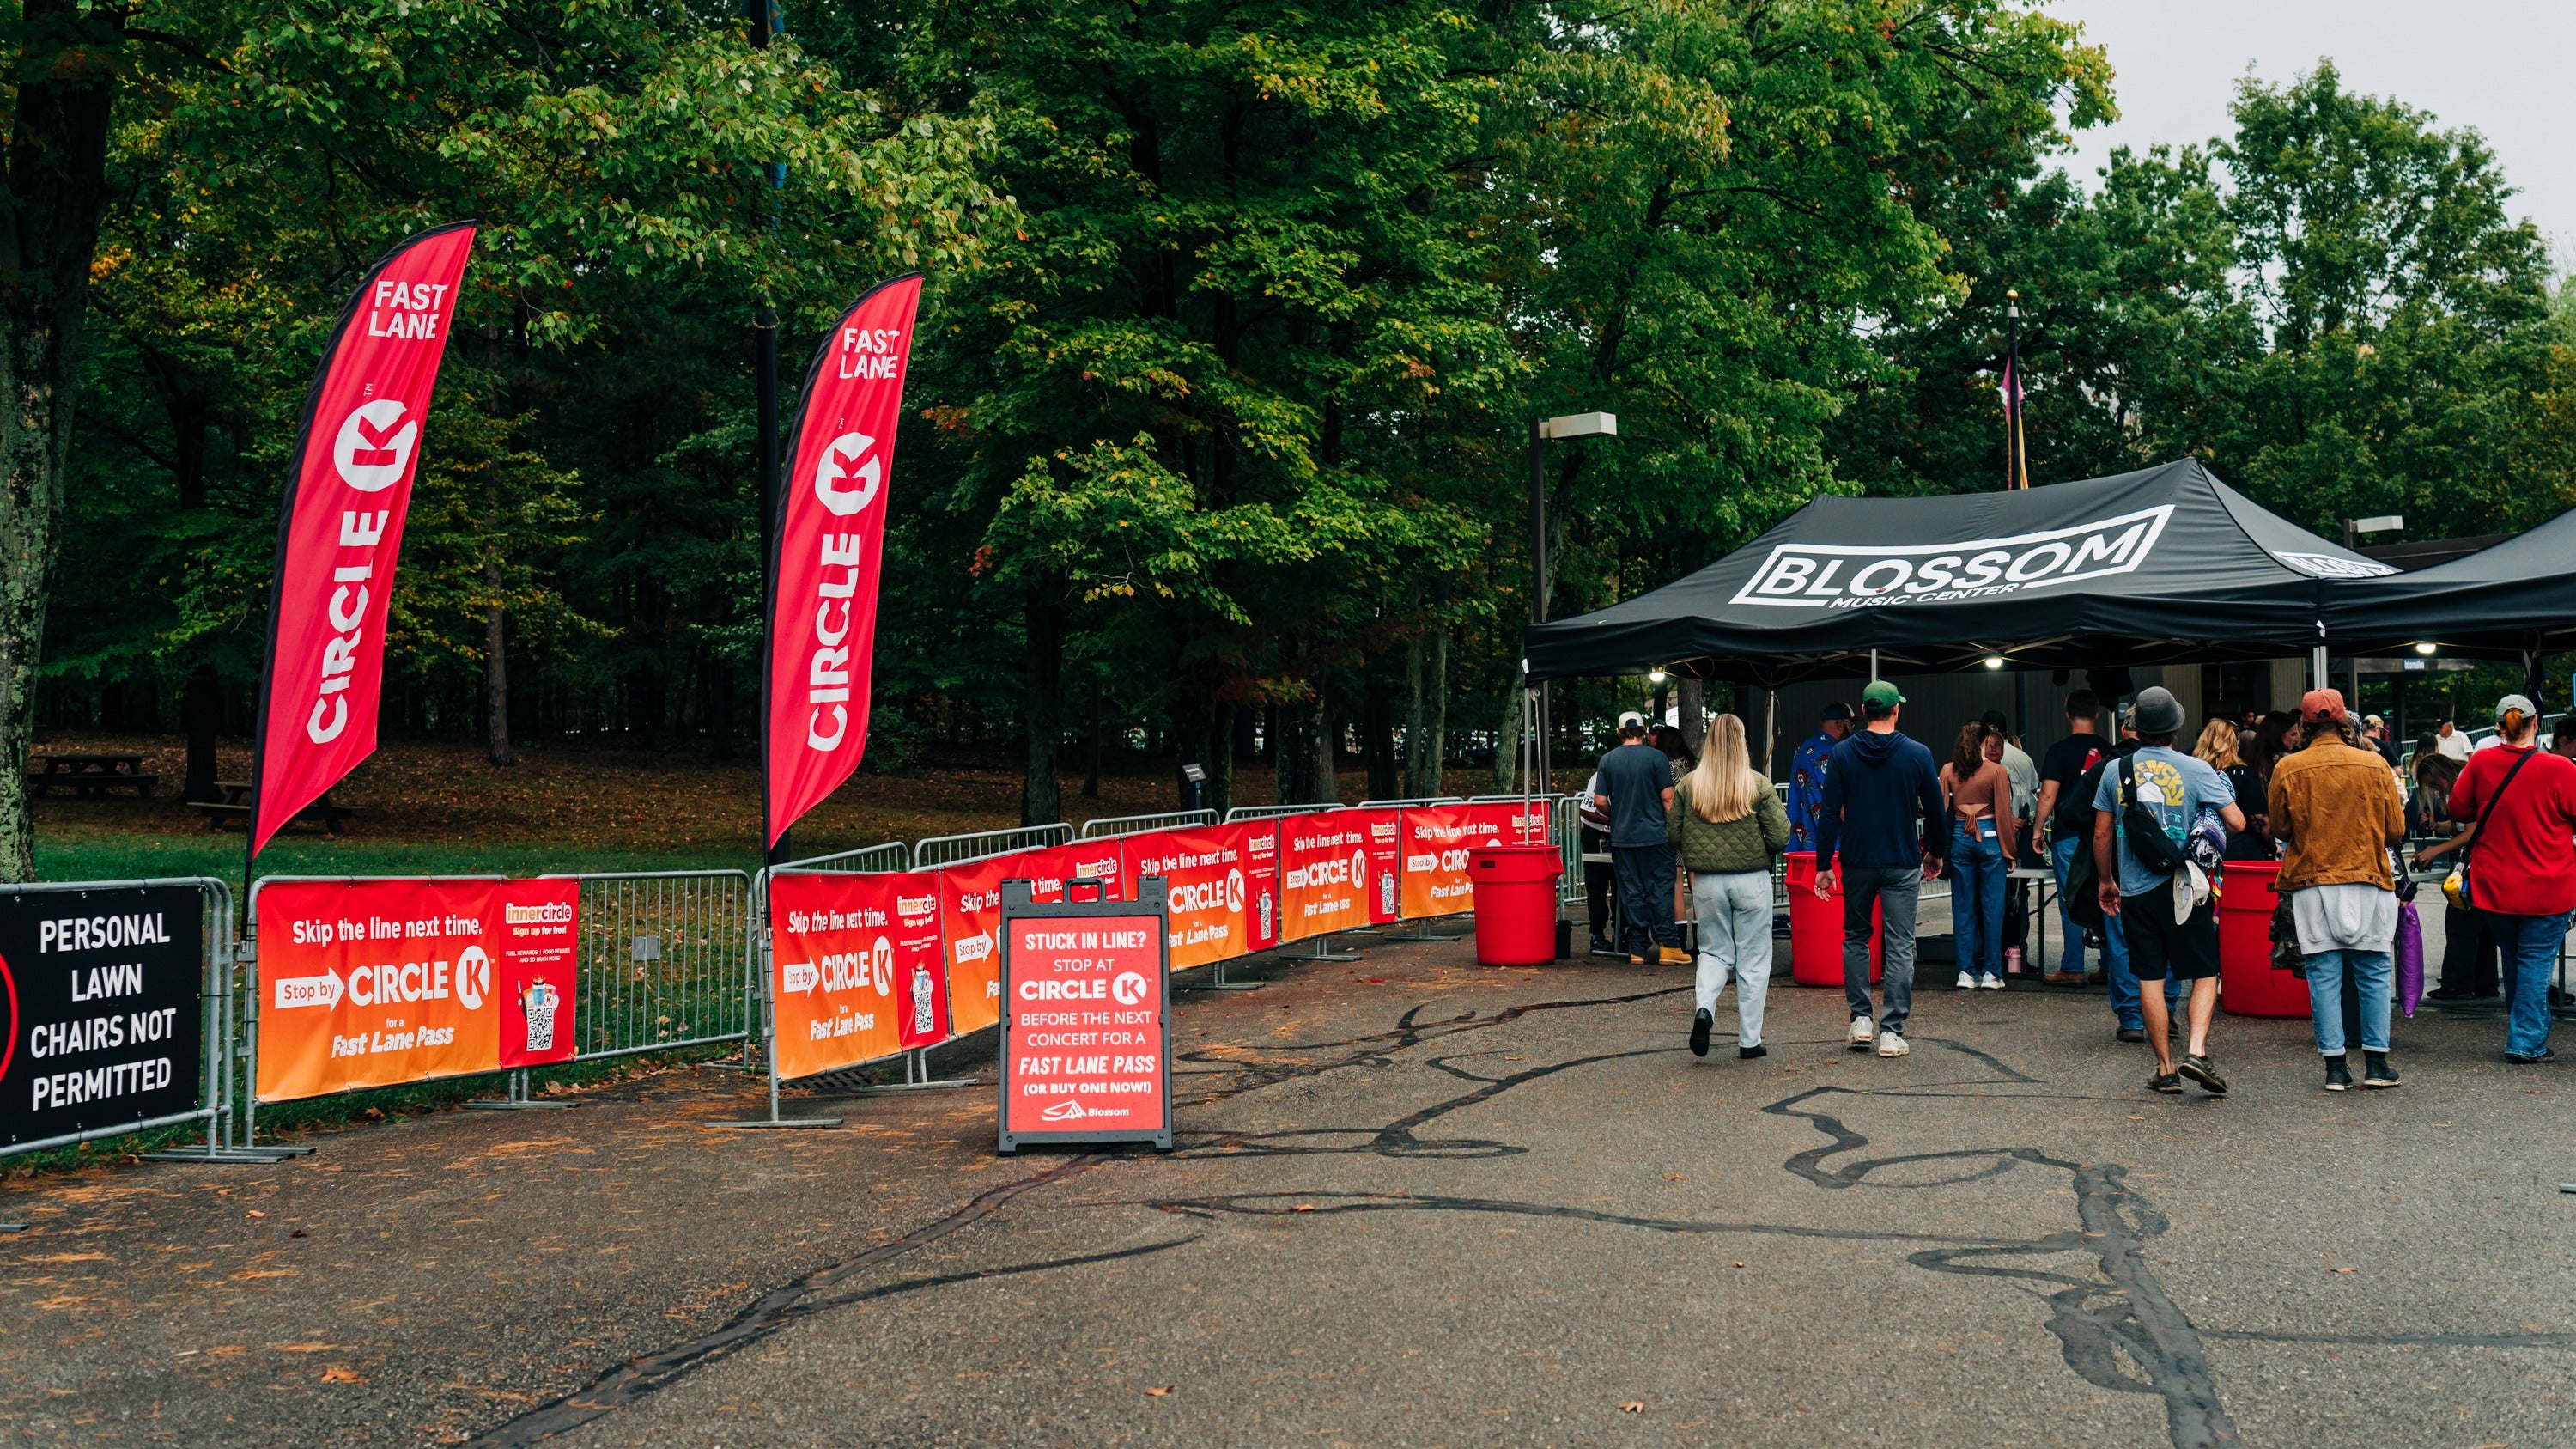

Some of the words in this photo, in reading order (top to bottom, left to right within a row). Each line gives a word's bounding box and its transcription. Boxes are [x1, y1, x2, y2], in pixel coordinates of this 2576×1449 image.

[375, 281, 447, 312] FAST
[369, 312, 438, 339] LANE
[843, 327, 900, 355] FAST
[839, 354, 898, 380] LANE
[1755, 522, 2148, 598] BLOSSOM
[1827, 594, 1912, 609] MUSIC
[1916, 582, 2025, 603] CENTER
[307, 509, 389, 745] CIRCLE
[808, 533, 860, 752] CIRCLE
[1330, 831, 1344, 846] net
[1346, 831, 1364, 844] time.
[1415, 825, 1433, 841] Skip
[1446, 825, 1461, 837] line
[1479, 822, 1500, 834] time.
[1076, 858, 1118, 878] innercircle
[1141, 857, 1160, 875] Skip
[1179, 853, 1197, 869] line
[1200, 849, 1220, 867] next
[1221, 847, 1238, 863] time.
[1425, 858, 1433, 868] by
[1441, 849, 1470, 872] CIRC
[1038, 876, 1063, 894] time.
[1309, 859, 1348, 887] CIRCE
[960, 892, 983, 914] Skip
[986, 889, 999, 908] the
[1170, 880, 1224, 914] CIRCLE
[1430, 885, 1449, 898] Fast
[1465, 882, 1473, 894] Pa
[506, 903, 572, 923] innercircle
[897, 895, 935, 915] innercie
[1304, 902, 1318, 917] Fst
[1319, 901, 1339, 915] Lane
[1340, 898, 1351, 910] ss
[40, 912, 171, 953] PERSONAL
[293, 919, 333, 947] Skip
[337, 917, 365, 941] the
[370, 916, 402, 940] line
[405, 916, 440, 938] next
[445, 914, 483, 935] time.
[513, 927, 529, 937] Sign
[531, 928, 540, 936] up
[542, 926, 552, 935] for
[553, 925, 567, 934] free!
[787, 910, 809, 937] Skip
[811, 910, 828, 932] the
[829, 909, 845, 931] line
[864, 906, 888, 928] time.
[1025, 932, 1077, 950] STUCK
[1081, 932, 1097, 949] IN
[1102, 931, 1146, 949] LINE?
[1169, 931, 1184, 947] st
[1186, 929, 1208, 945] Lane
[1209, 924, 1229, 941] Pass
[959, 944, 975, 956] Stop
[976, 940, 987, 953] by
[802, 968, 814, 985] by
[821, 951, 870, 994] CIRCLE
[1054, 959, 1092, 972] STOP
[1096, 959, 1115, 971] AT
[72, 963, 142, 1002] LAWN
[284, 983, 315, 1001] Stop
[319, 981, 336, 998] by
[348, 960, 449, 1007] CIRCLE
[986, 980, 1000, 999] Fa
[1019, 979, 1107, 1001] CIRCLE
[386, 1018, 398, 1028] for
[398, 1019, 404, 1027] a
[811, 1018, 833, 1041] Fast
[833, 1016, 853, 1038] Lane
[854, 1012, 874, 1032] Pass
[1021, 1012, 1078, 1026] BEFORE
[1082, 1012, 1109, 1025] THE
[1115, 1011, 1152, 1024] NEXT
[31, 1014, 124, 1059] CHAIRS
[131, 1008, 177, 1044] NOT
[331, 1032, 368, 1059] Fast
[370, 1031, 415, 1054] Lane
[416, 1026, 454, 1048] Pass
[1027, 1033, 1098, 1046] CONCERT
[1102, 1032, 1131, 1045] FOR
[1135, 1032, 1146, 1044] A
[1019, 1056, 1062, 1075] FAST
[1066, 1056, 1109, 1075] LANE
[1113, 1056, 1156, 1074] PASS
[33, 1057, 171, 1111] PERMITTED
[1024, 1083, 1046, 1097] (OR
[1049, 1083, 1077, 1094] BUY
[1079, 1082, 1108, 1093] ONE
[1109, 1081, 1152, 1094] NOW!)
[1088, 1107, 1130, 1117] Blossom
